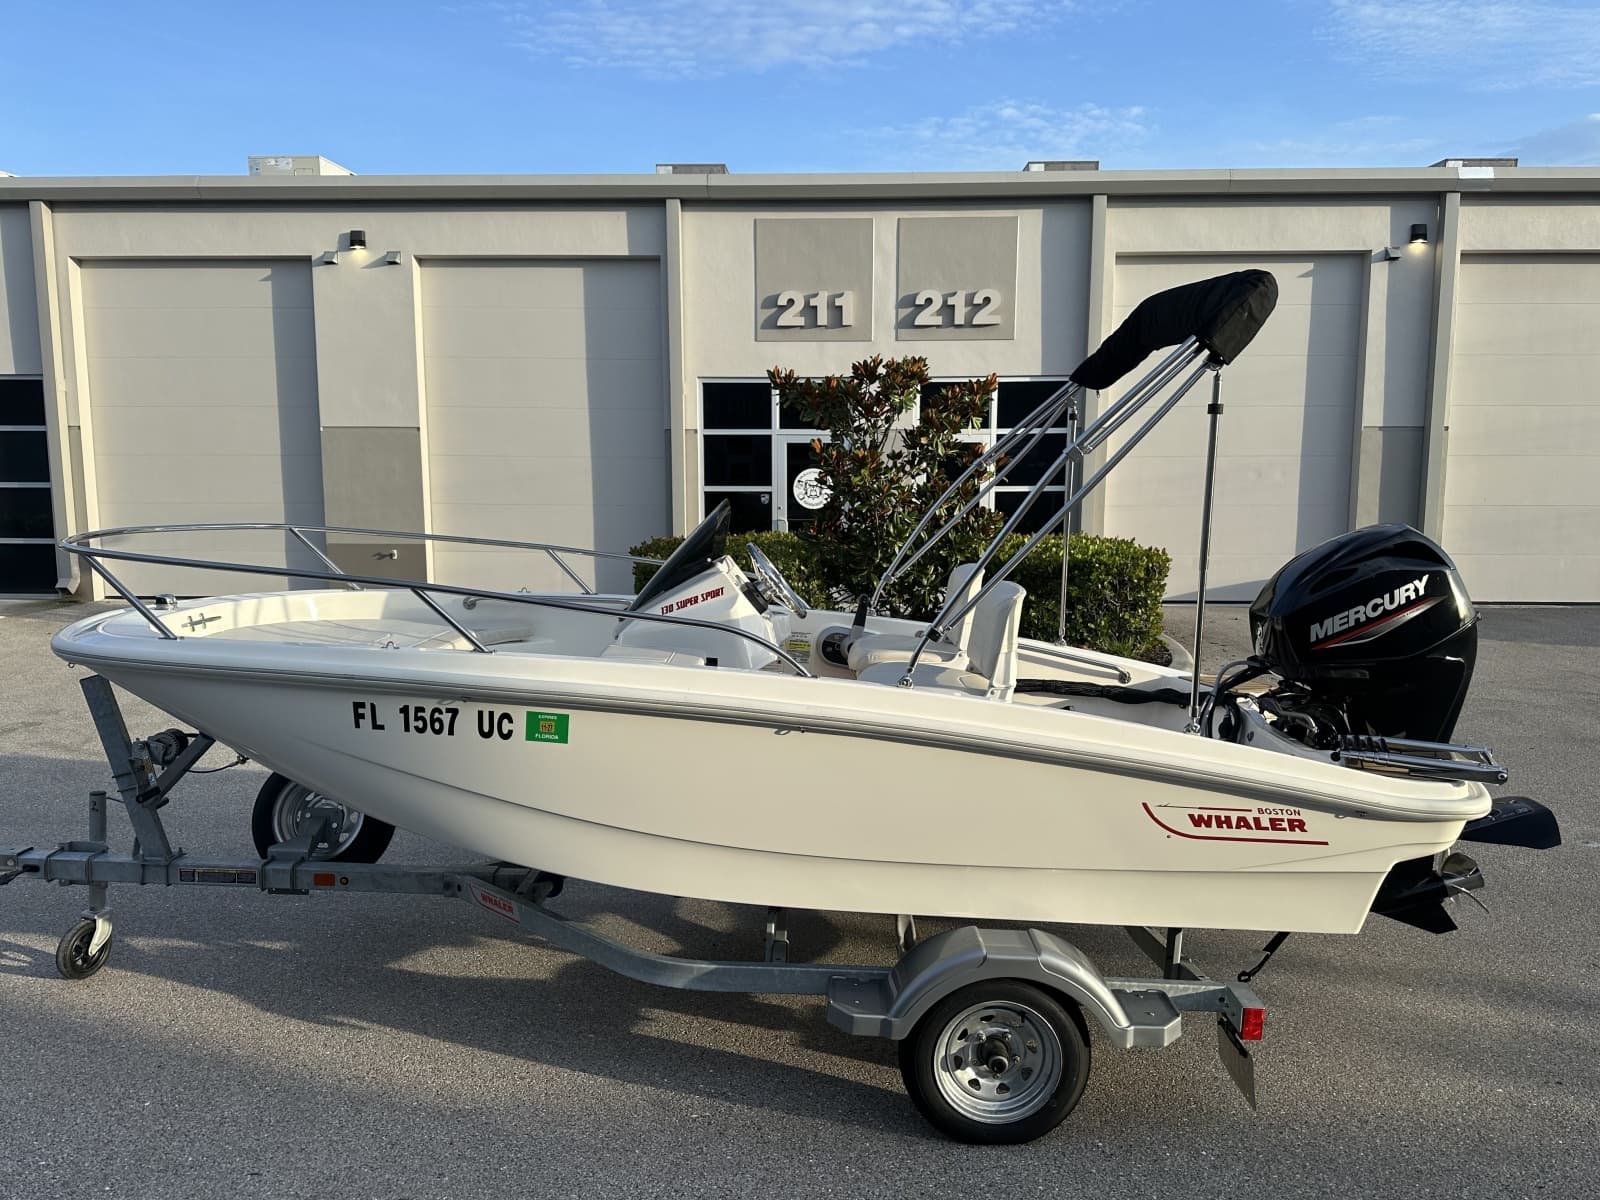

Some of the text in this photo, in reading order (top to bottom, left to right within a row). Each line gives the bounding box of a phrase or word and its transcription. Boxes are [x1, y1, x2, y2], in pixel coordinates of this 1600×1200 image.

[777, 290, 854, 327] 211
[914, 289, 1001, 326] 212
[661, 586, 725, 616] 130 SUPER SPORT
[1310, 574, 1430, 642] MERCURY
[352, 701, 514, 740] FL 1567 UC
[1188, 813, 1309, 833] WHALER
[1257, 807, 1301, 816] BOSTON
